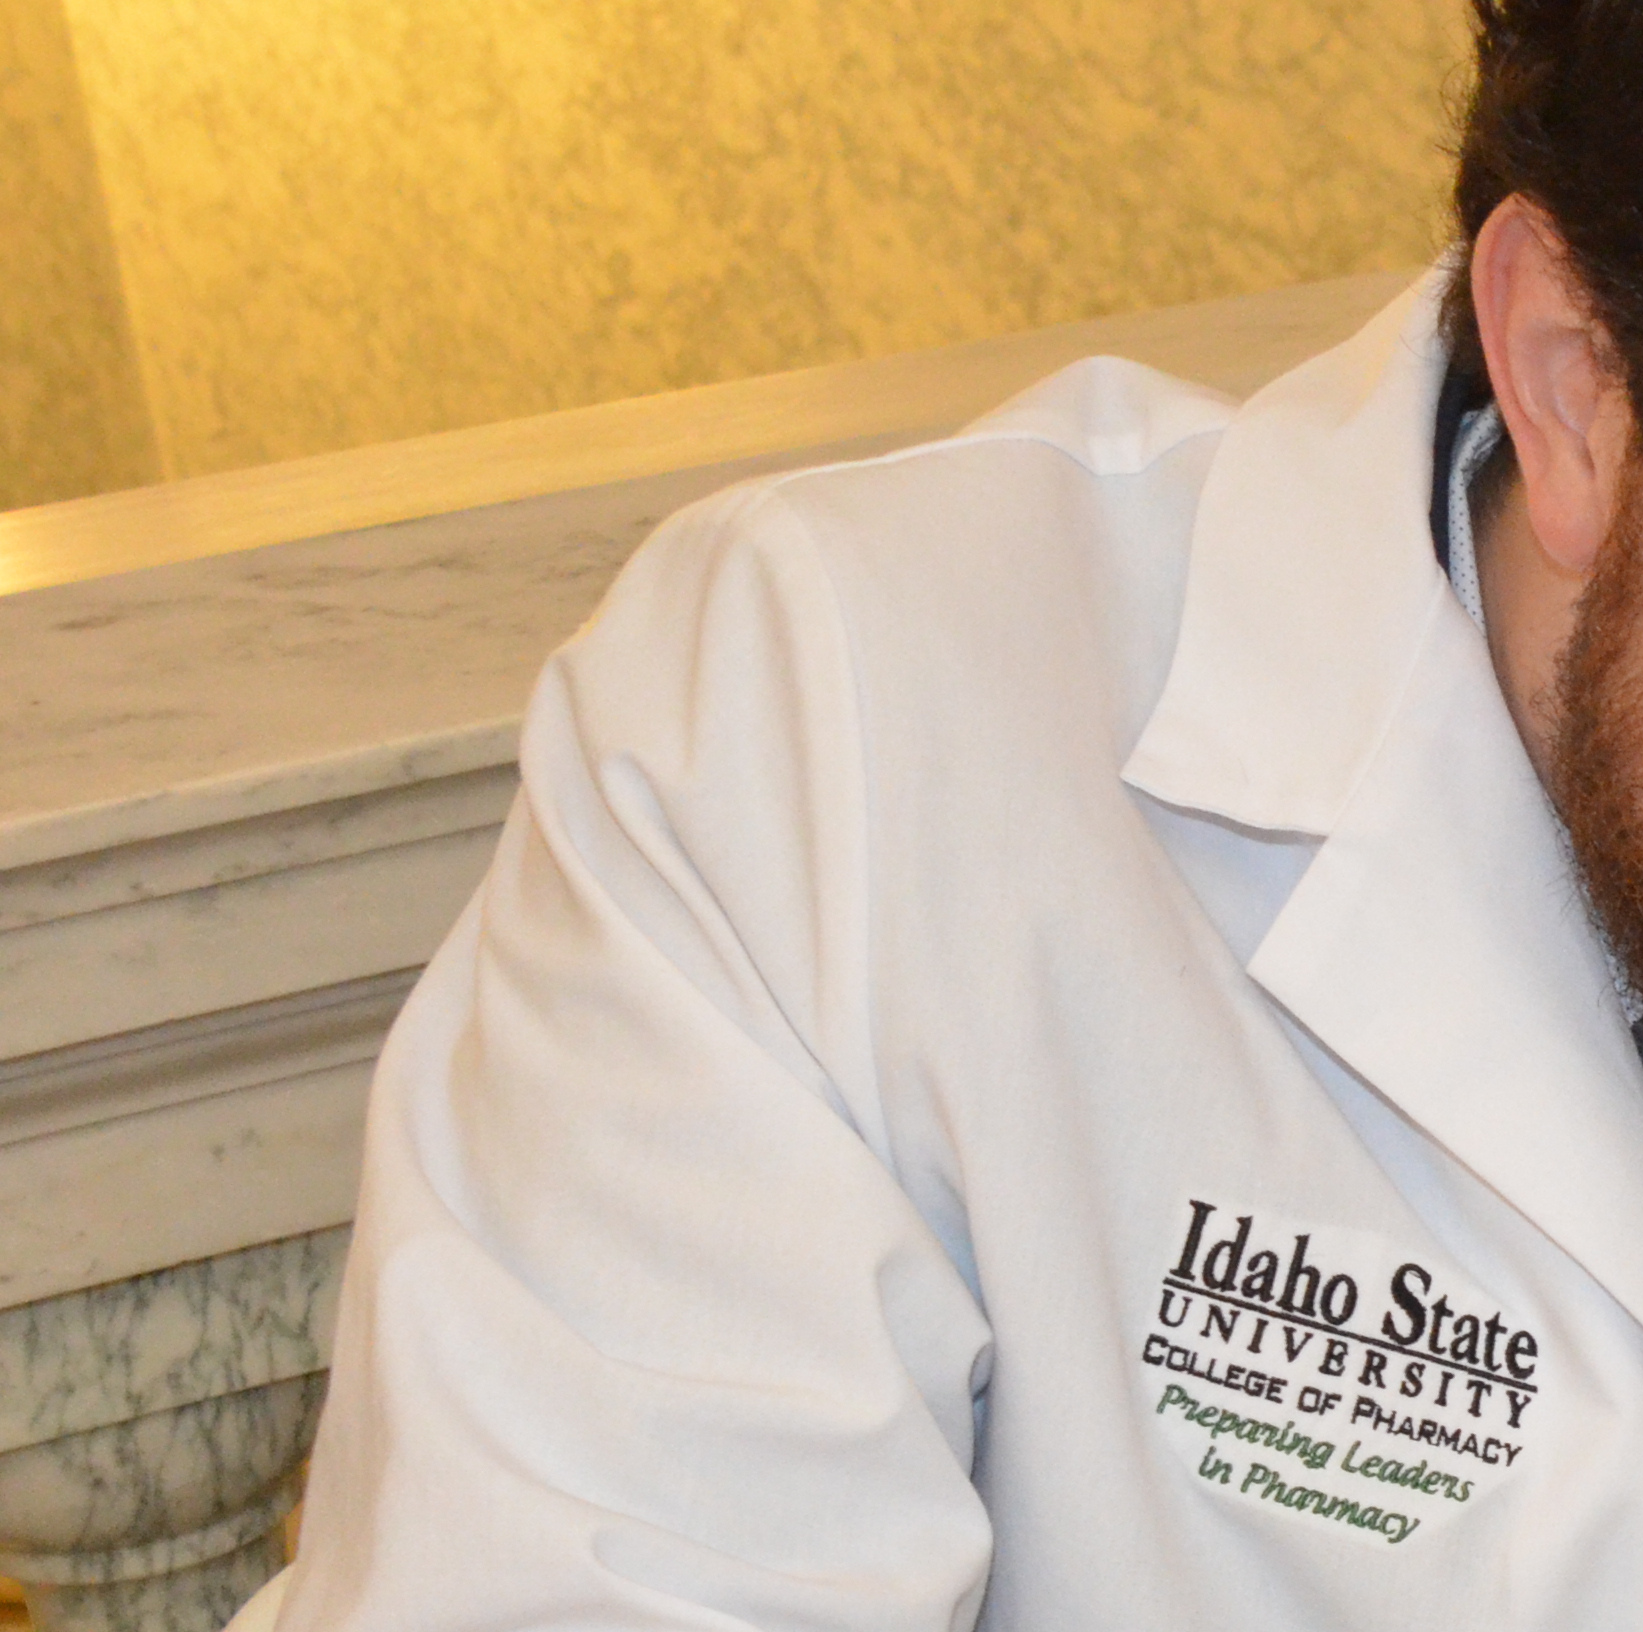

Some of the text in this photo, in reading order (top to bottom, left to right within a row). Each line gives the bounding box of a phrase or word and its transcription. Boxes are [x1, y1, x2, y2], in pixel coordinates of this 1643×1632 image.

[1169, 1199, 1538, 1379] Idaho State
[1142, 1334, 1523, 1467] COLLEGE OF PHARMACY
[1158, 1290, 1532, 1428] UNIVERSITY
[1156, 1383, 1475, 1502] Preparing Leaders
[1198, 1446, 1420, 1544] in Pharmacy
